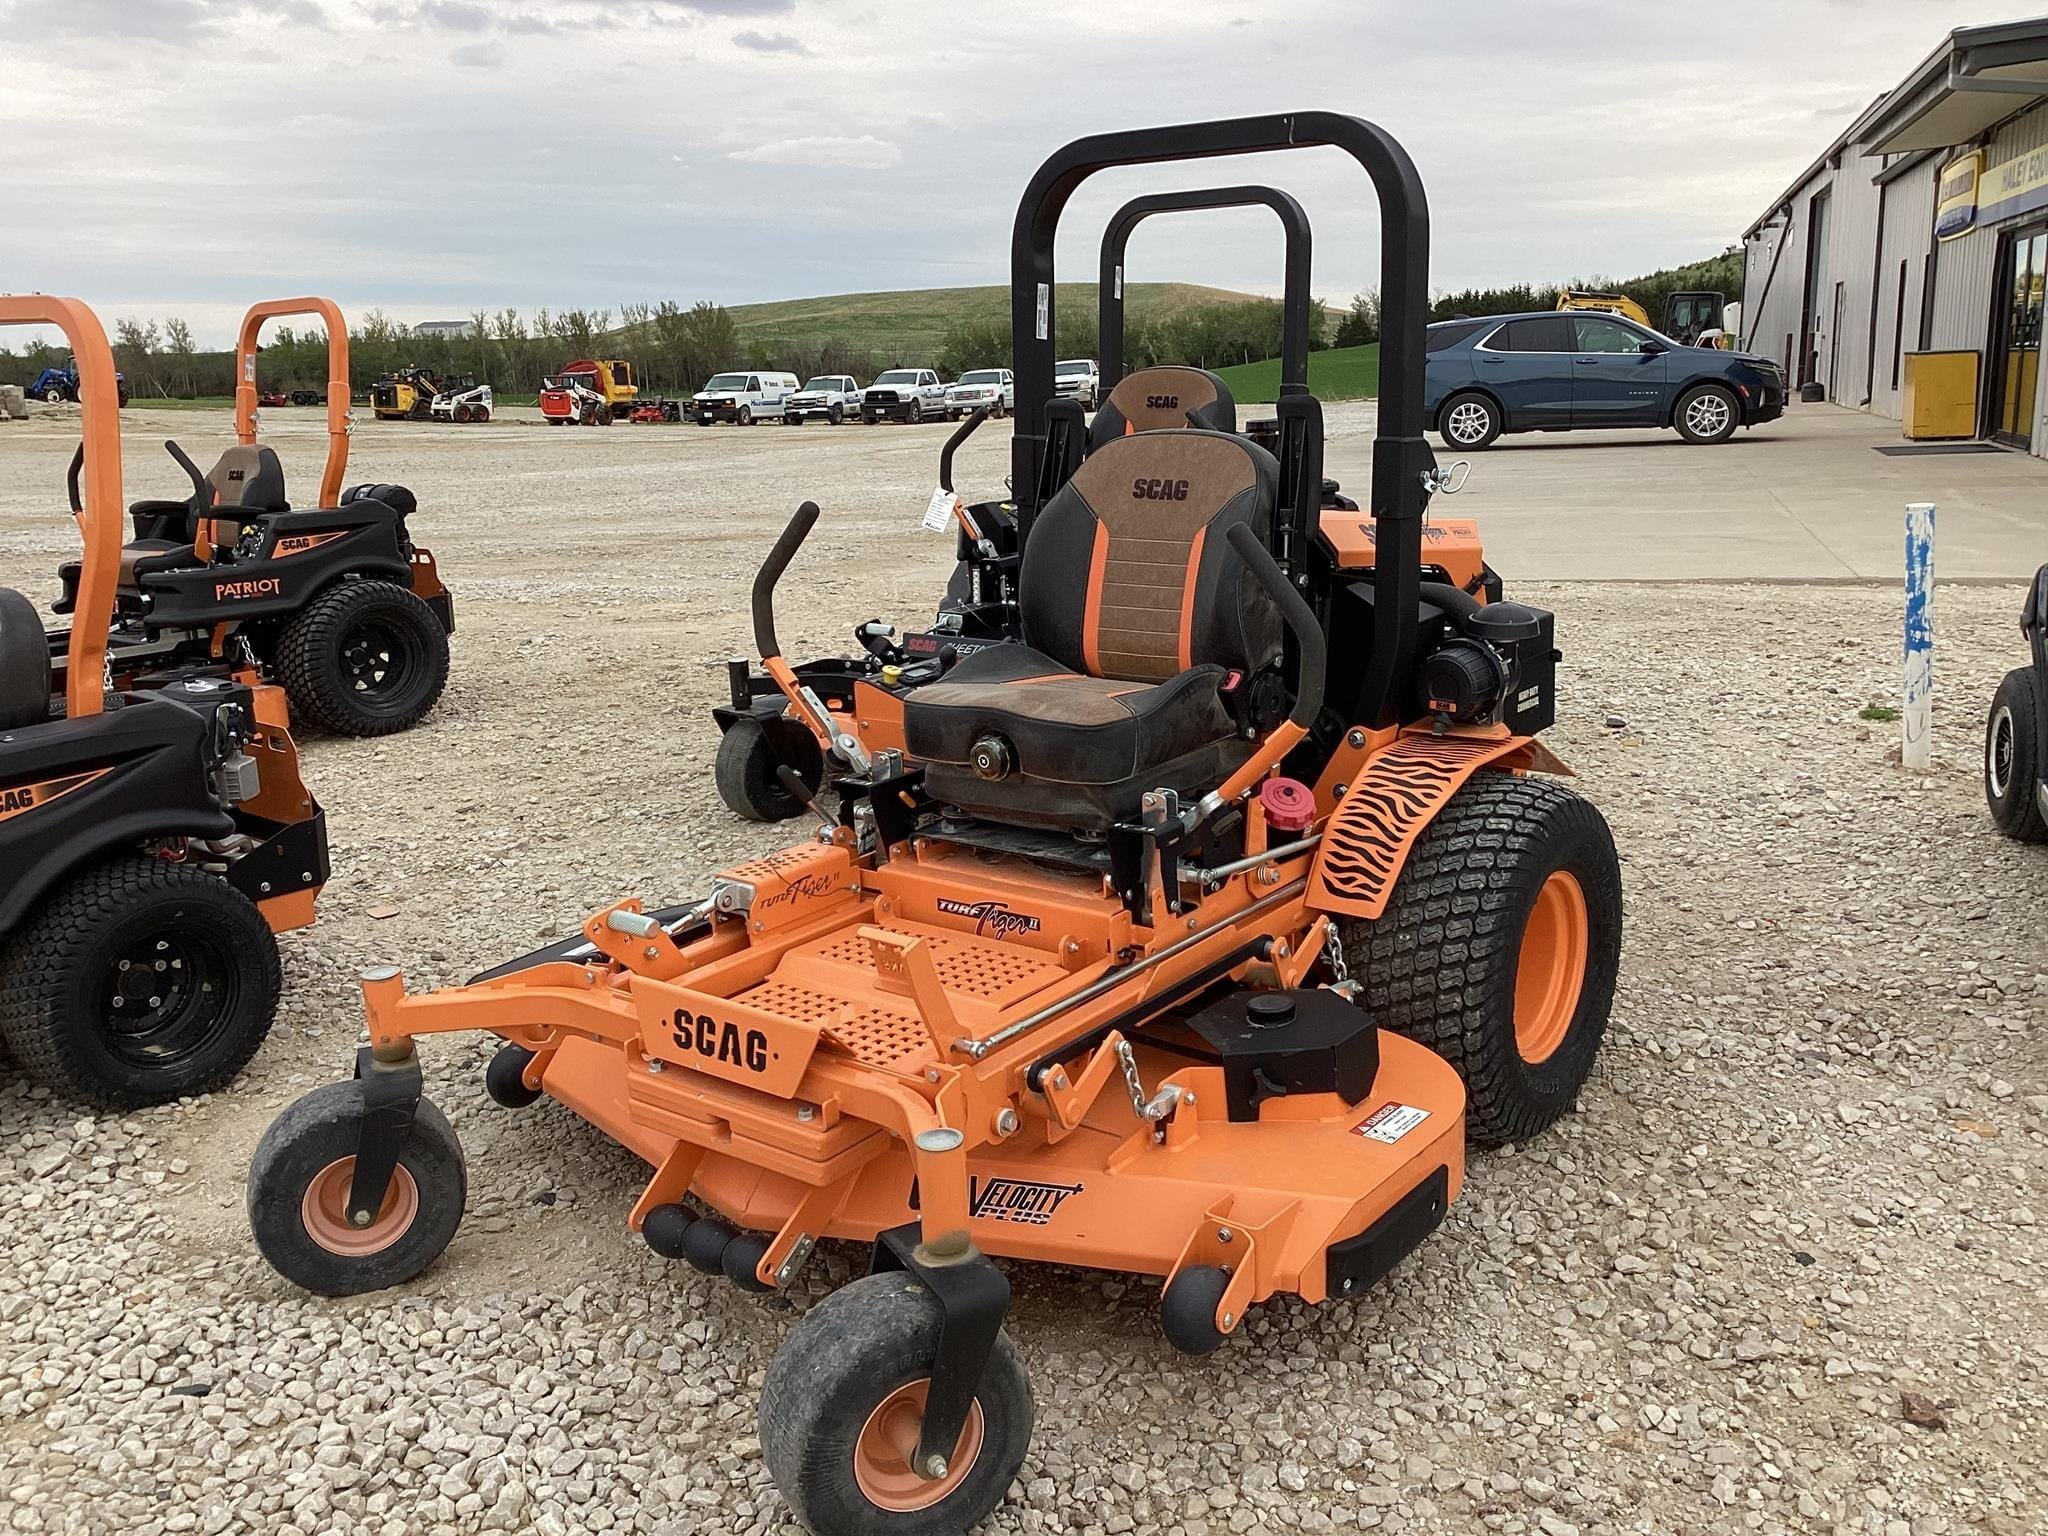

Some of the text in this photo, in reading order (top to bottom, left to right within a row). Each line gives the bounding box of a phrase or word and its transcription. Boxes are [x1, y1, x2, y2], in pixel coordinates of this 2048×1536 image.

[1145, 395, 1179, 409] SCAG
[1132, 478, 1189, 501] SCAG
[281, 538, 310, 550] SCAG
[215, 579, 280, 601] PATRIOT
[908, 639, 937, 652] SCAG
[939, 901, 981, 916] TURF
[969, 901, 1029, 941] Tiger
[673, 1008, 768, 1073] SCAG
[977, 1206, 1051, 1225] PLUS
